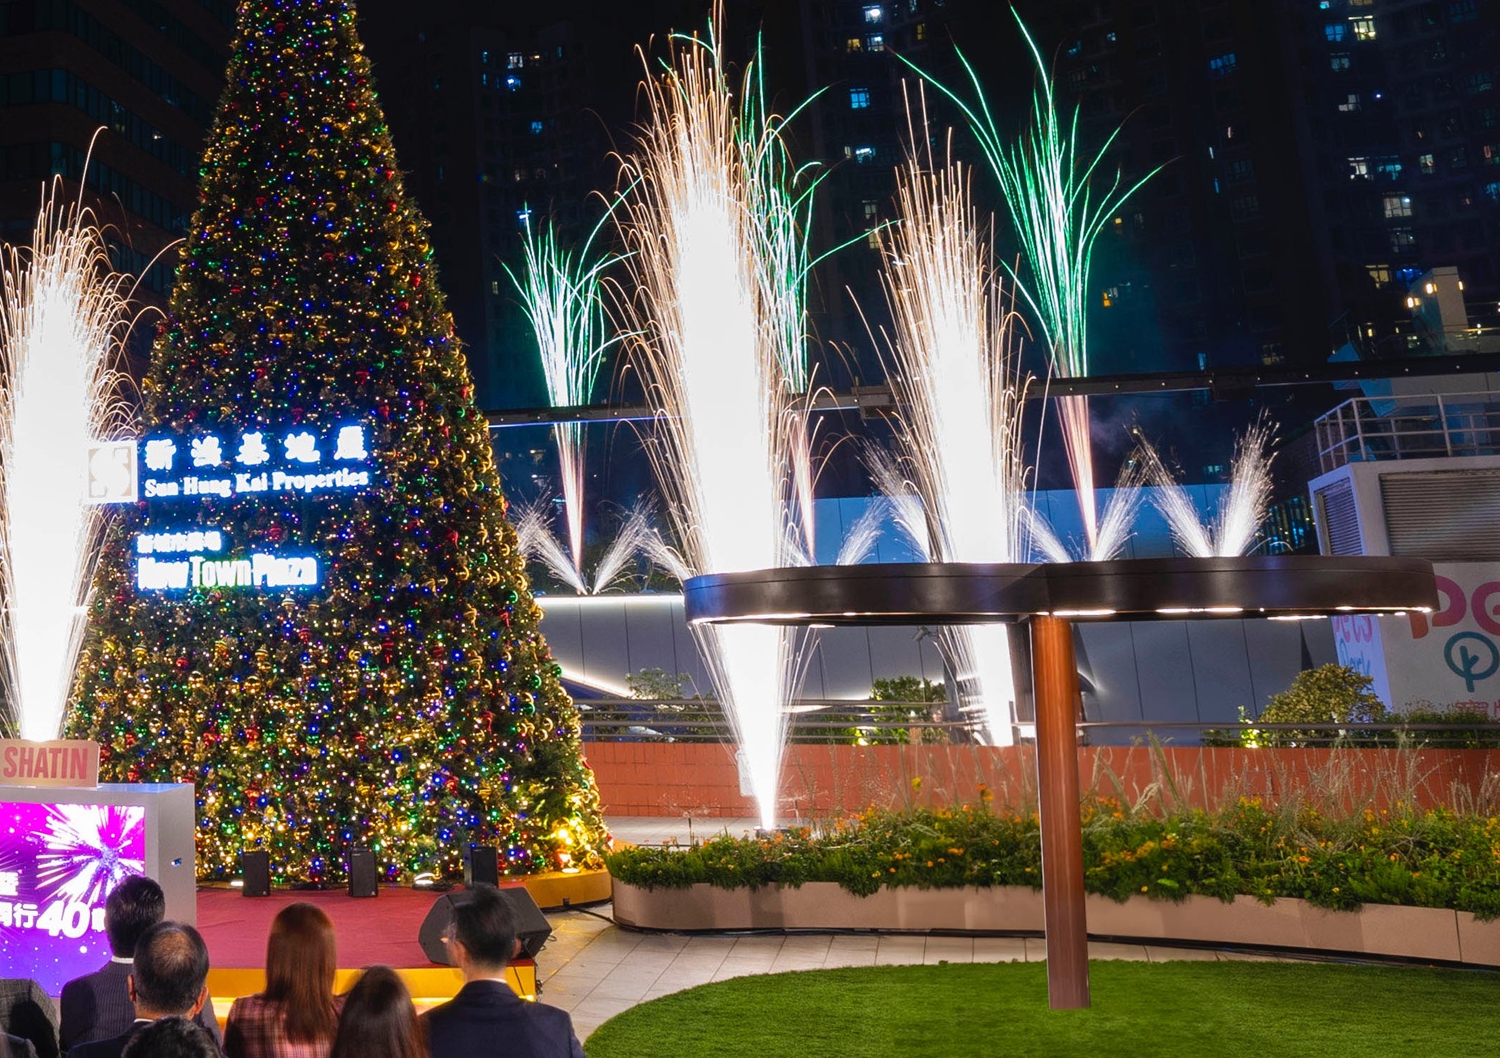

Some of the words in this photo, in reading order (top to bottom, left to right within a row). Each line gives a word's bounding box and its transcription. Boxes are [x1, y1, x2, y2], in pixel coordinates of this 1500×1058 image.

[145, 479, 178, 497] Sun
[183, 477, 231, 497] Hung
[235, 473, 267, 492] Kai
[272, 468, 368, 492] Properties
[190, 556, 251, 587] Town
[253, 554, 317, 587] Plaza
[3, 746, 89, 780] SHATIN
